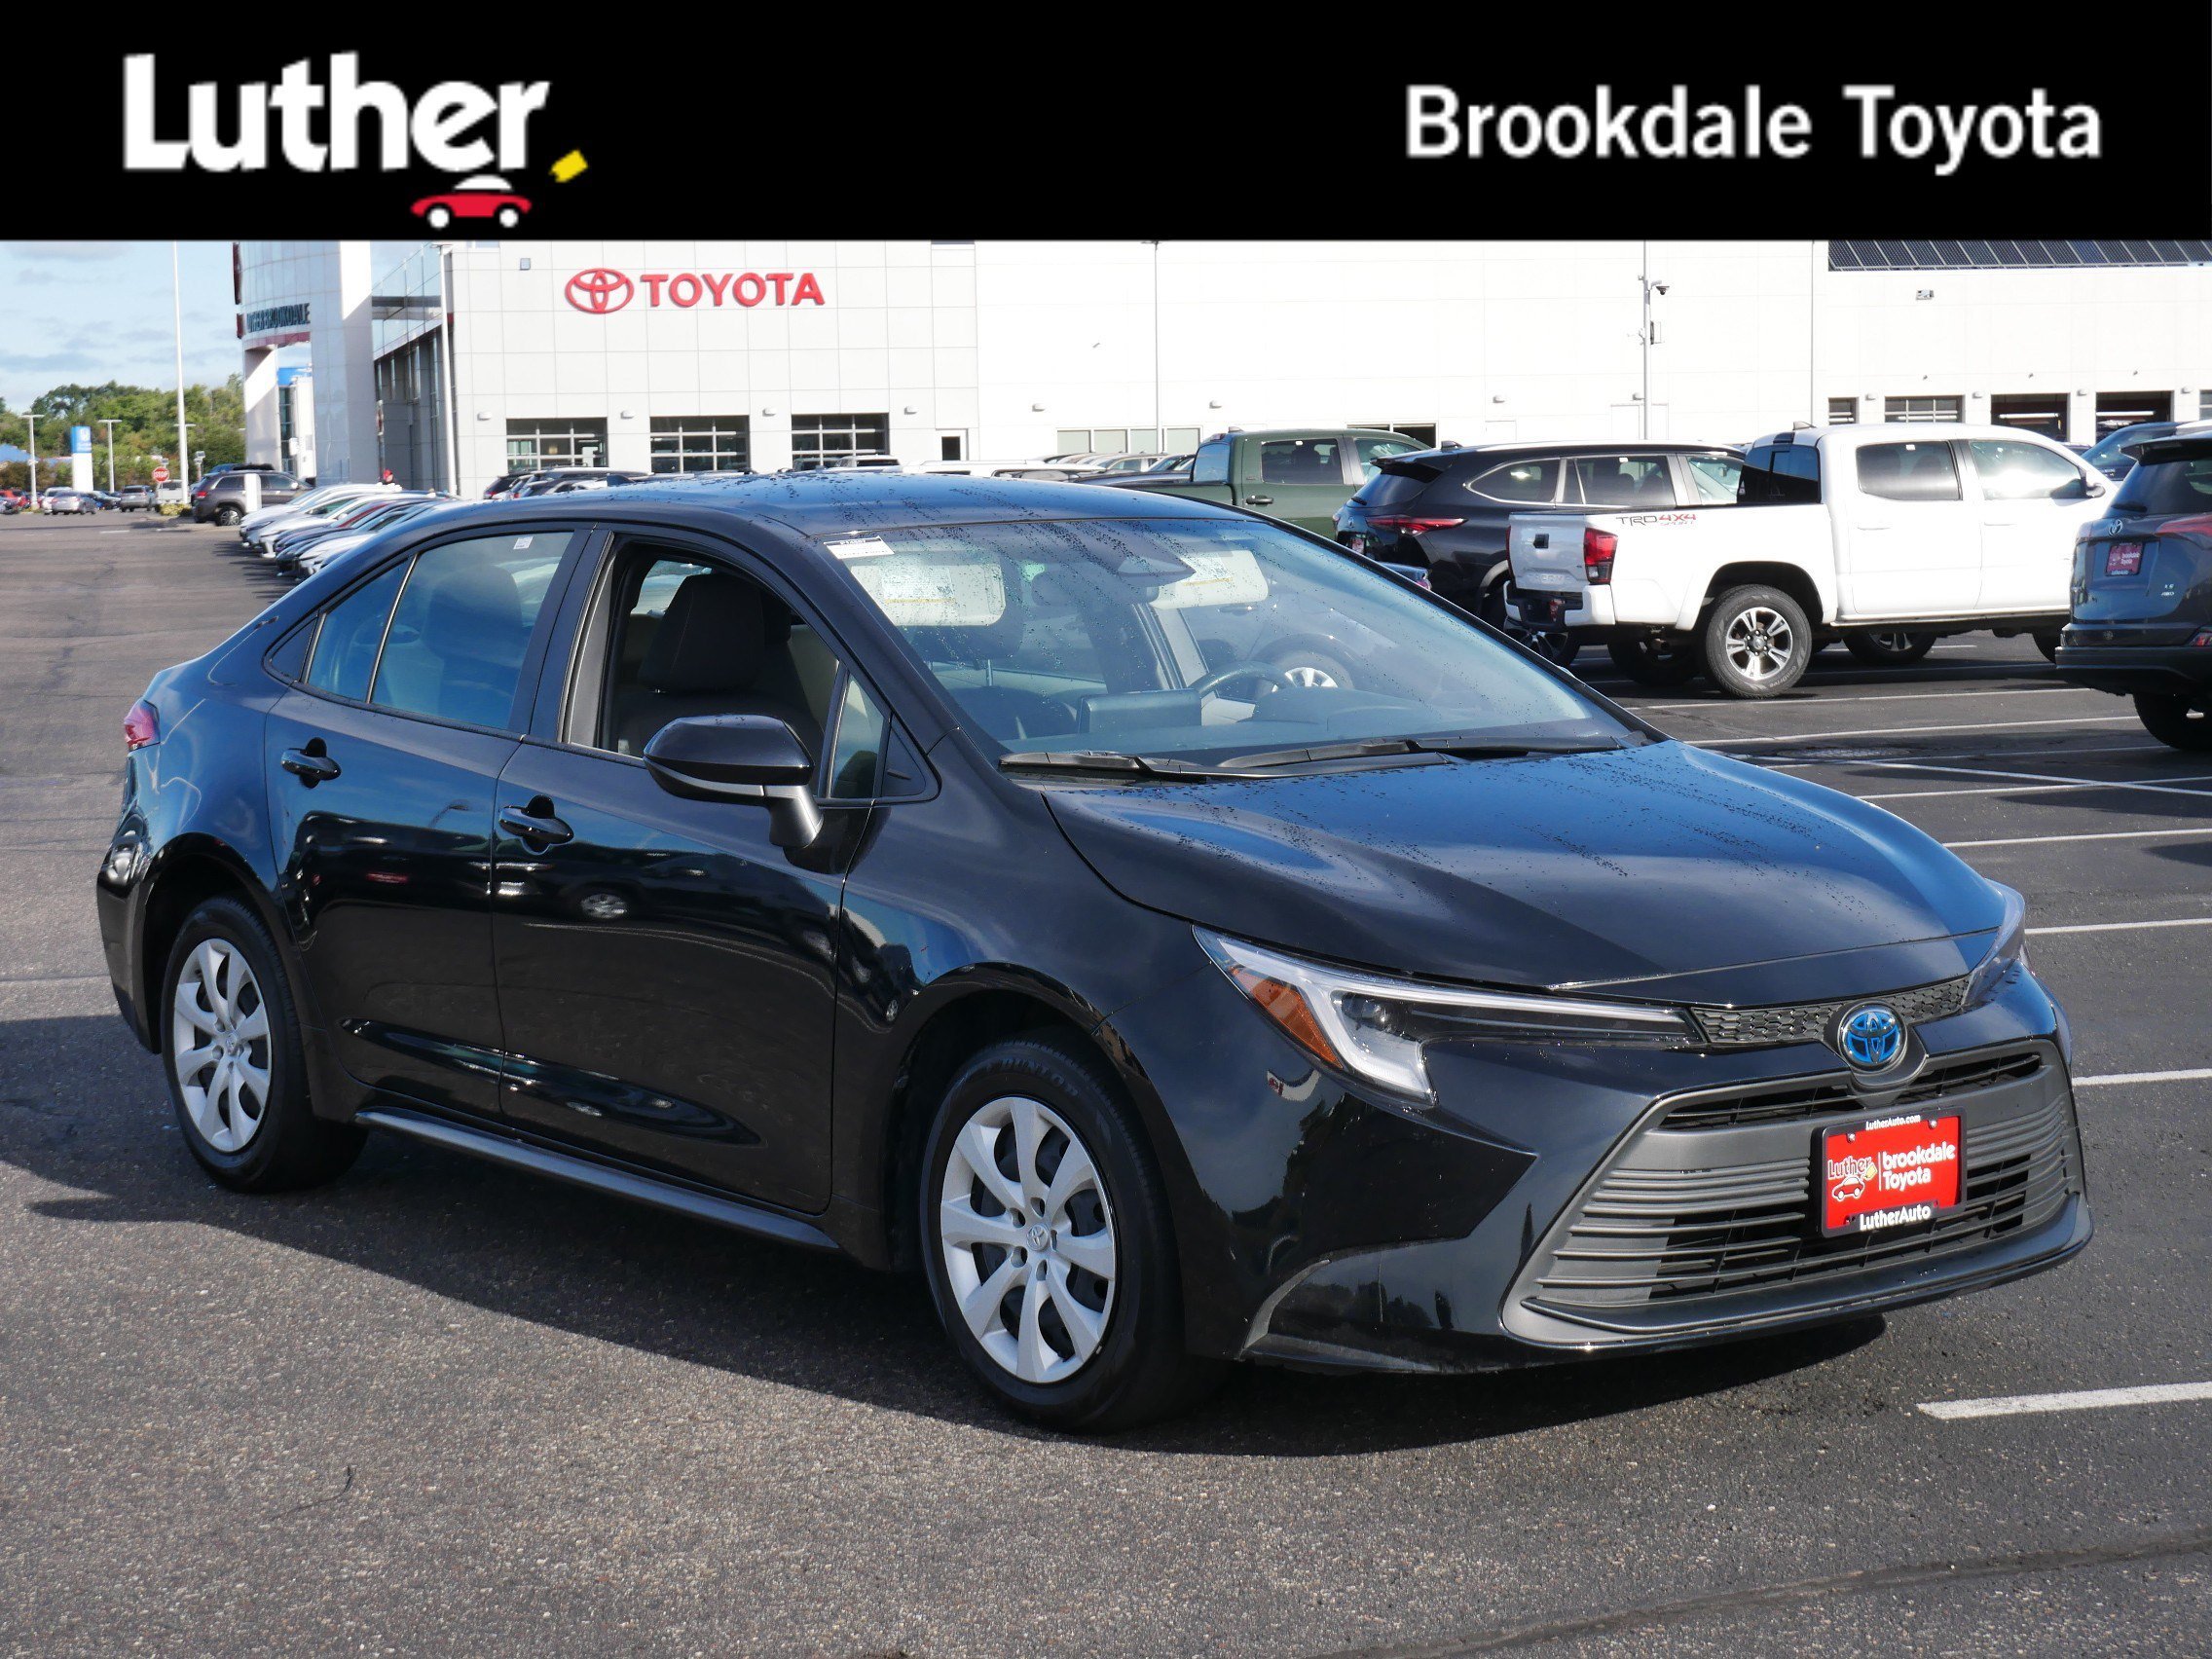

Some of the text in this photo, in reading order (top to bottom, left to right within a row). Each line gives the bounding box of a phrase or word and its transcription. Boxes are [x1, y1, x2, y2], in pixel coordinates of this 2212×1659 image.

[640, 273, 826, 308] TOYOTA
[1865, 1114, 1921, 1131] LutherAuto.com
[1827, 1156, 1872, 1180] Luther
[1882, 1141, 1956, 1170] brookdale
[1882, 1166, 1932, 1192] Toyota
[1860, 1204, 1932, 1232] LutherAuto
